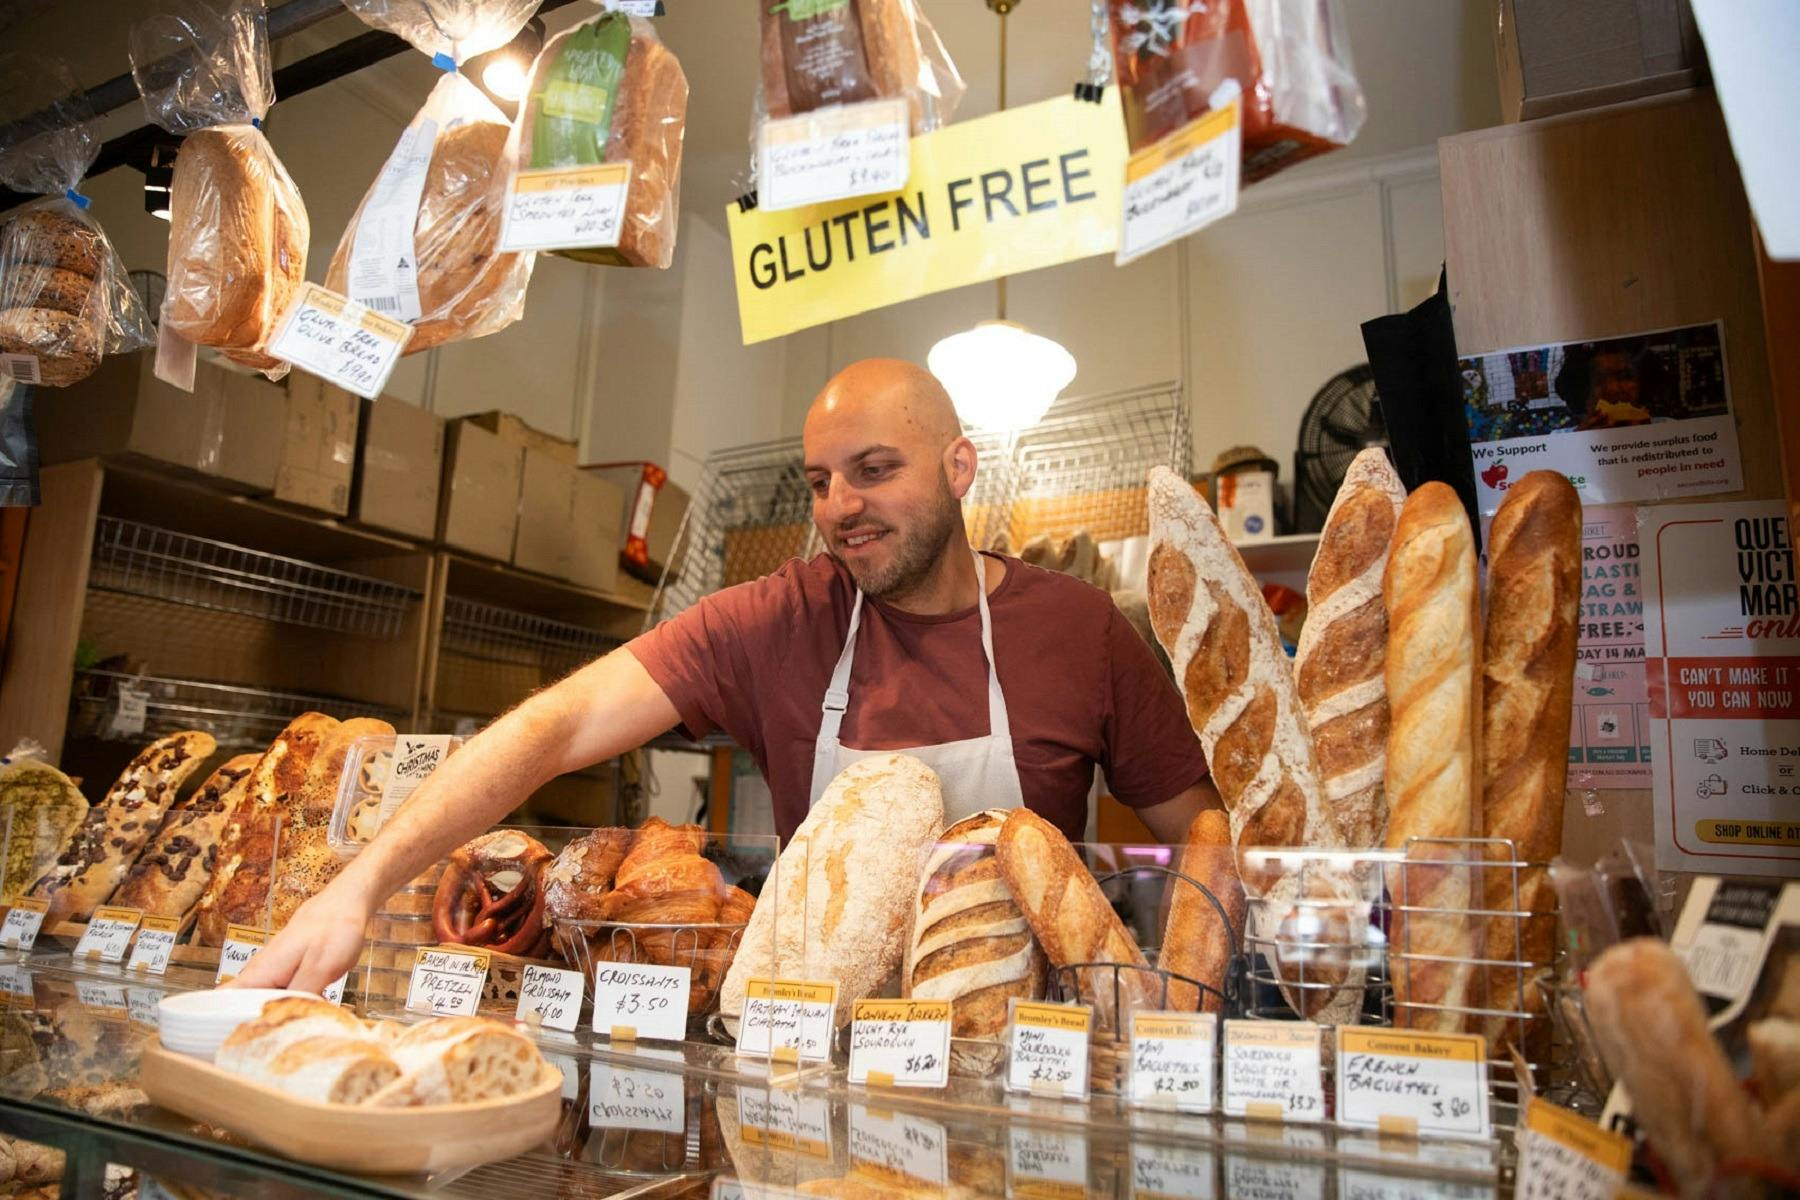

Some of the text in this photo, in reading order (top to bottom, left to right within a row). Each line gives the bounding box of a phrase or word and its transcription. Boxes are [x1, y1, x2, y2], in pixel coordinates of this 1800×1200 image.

[749, 148, 1097, 291] GLUTEN FREE
[1473, 443, 1547, 459] We Support
[1590, 431, 1717, 453] We provide surplus food
[1598, 446, 1713, 466] that is redistributed to
[1637, 459, 1725, 478] people in need
[1583, 543, 1640, 560] ROUD
[1583, 562, 1640, 580] LASTI
[1738, 549, 1796, 583] VICT
[1581, 583, 1637, 598] AG &
[1740, 583, 1798, 616] MAR
[1576, 647, 1646, 660] DAY 14 MA
[1680, 667, 1788, 685] CAN'T MAKE IT
[1688, 690, 1793, 708] YOU CAN NOW
[1740, 746, 1778, 757] Home
[396, 749, 441, 776] CHRISTMAS
[1779, 767, 1793, 776] or
[1742, 785, 1776, 796] Click
[1778, 785, 1789, 796] &
[1714, 823, 1741, 838] SHOP
[1746, 824, 1782, 840] ONLINE
[419, 952, 450, 967] BAKER
[421, 972, 472, 994] PRETZEL
[524, 966, 562, 983] ALMOND
[599, 968, 680, 989] CROISSANTS
[522, 983, 572, 1001] CROISSANT
[534, 1002, 563, 1019] $6.00
[615, 993, 669, 1015] $3.50
[855, 1002, 948, 1022] CONVENT BAKERY
[1018, 1013, 1086, 1028] Bromley's Bread
[1367, 1038, 1452, 1056] Convent Bakery
[1347, 1054, 1420, 1075] FRENCH
[1345, 1072, 1440, 1096] BAGUETTES
